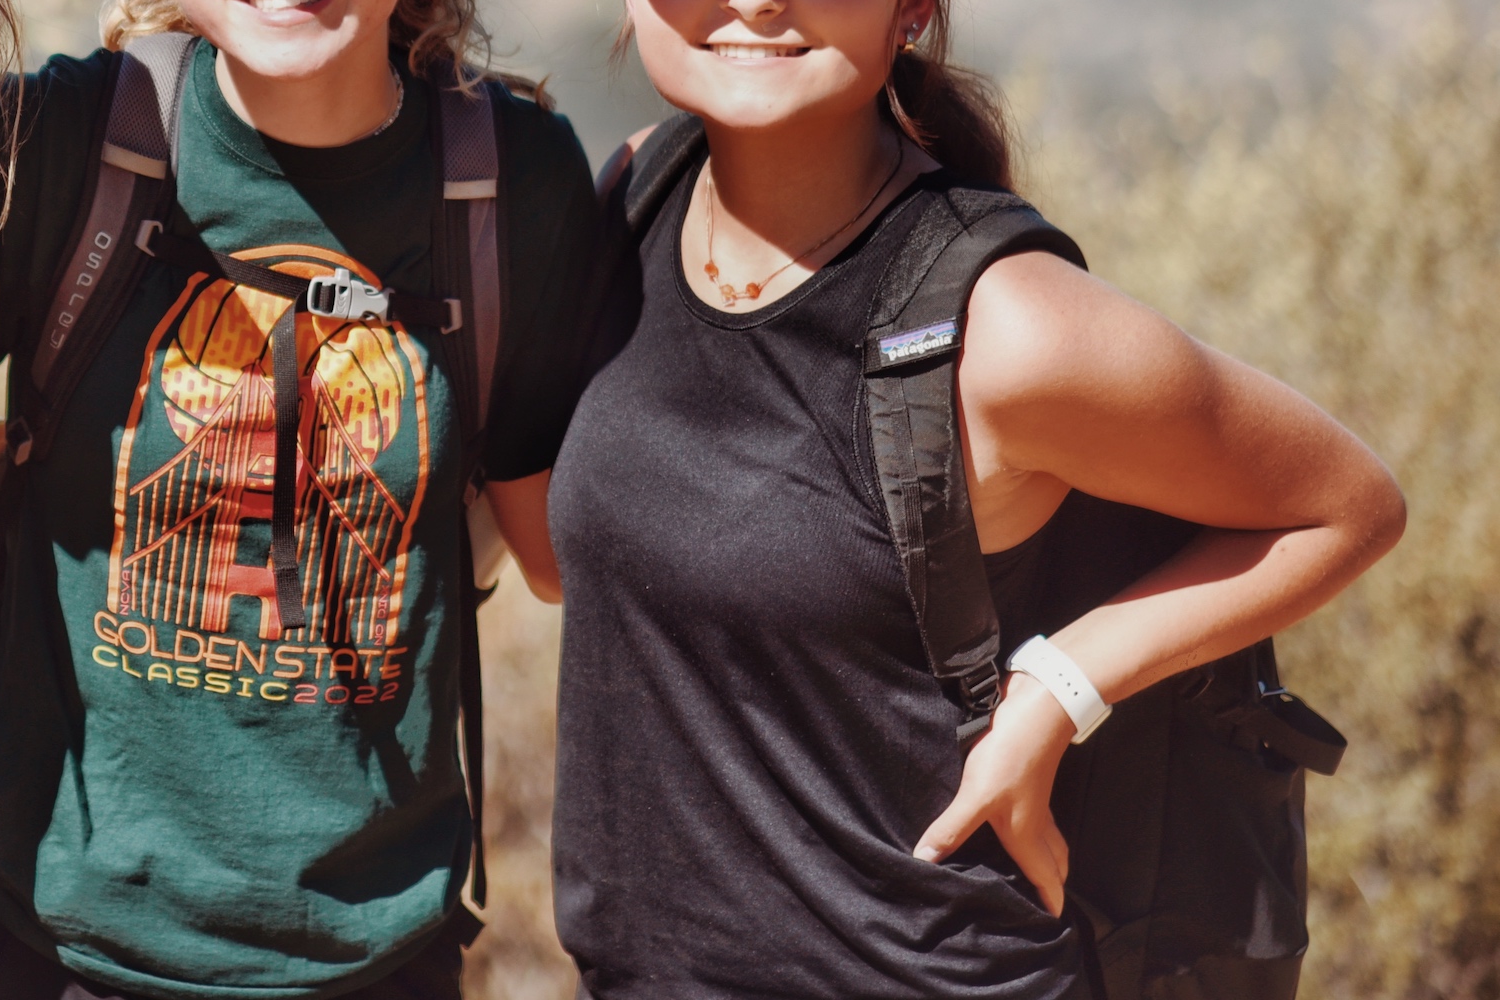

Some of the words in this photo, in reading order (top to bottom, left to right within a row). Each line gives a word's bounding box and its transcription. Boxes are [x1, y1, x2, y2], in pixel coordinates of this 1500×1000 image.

[888, 334, 954, 362] patagonia
[119, 570, 131, 617] NOVA
[93, 610, 268, 675] GOLDEN
[273, 645, 409, 680] STATE
[373, 623, 385, 647] NO
[92, 644, 289, 701] CLASSIC
[293, 681, 399, 704] 2022
